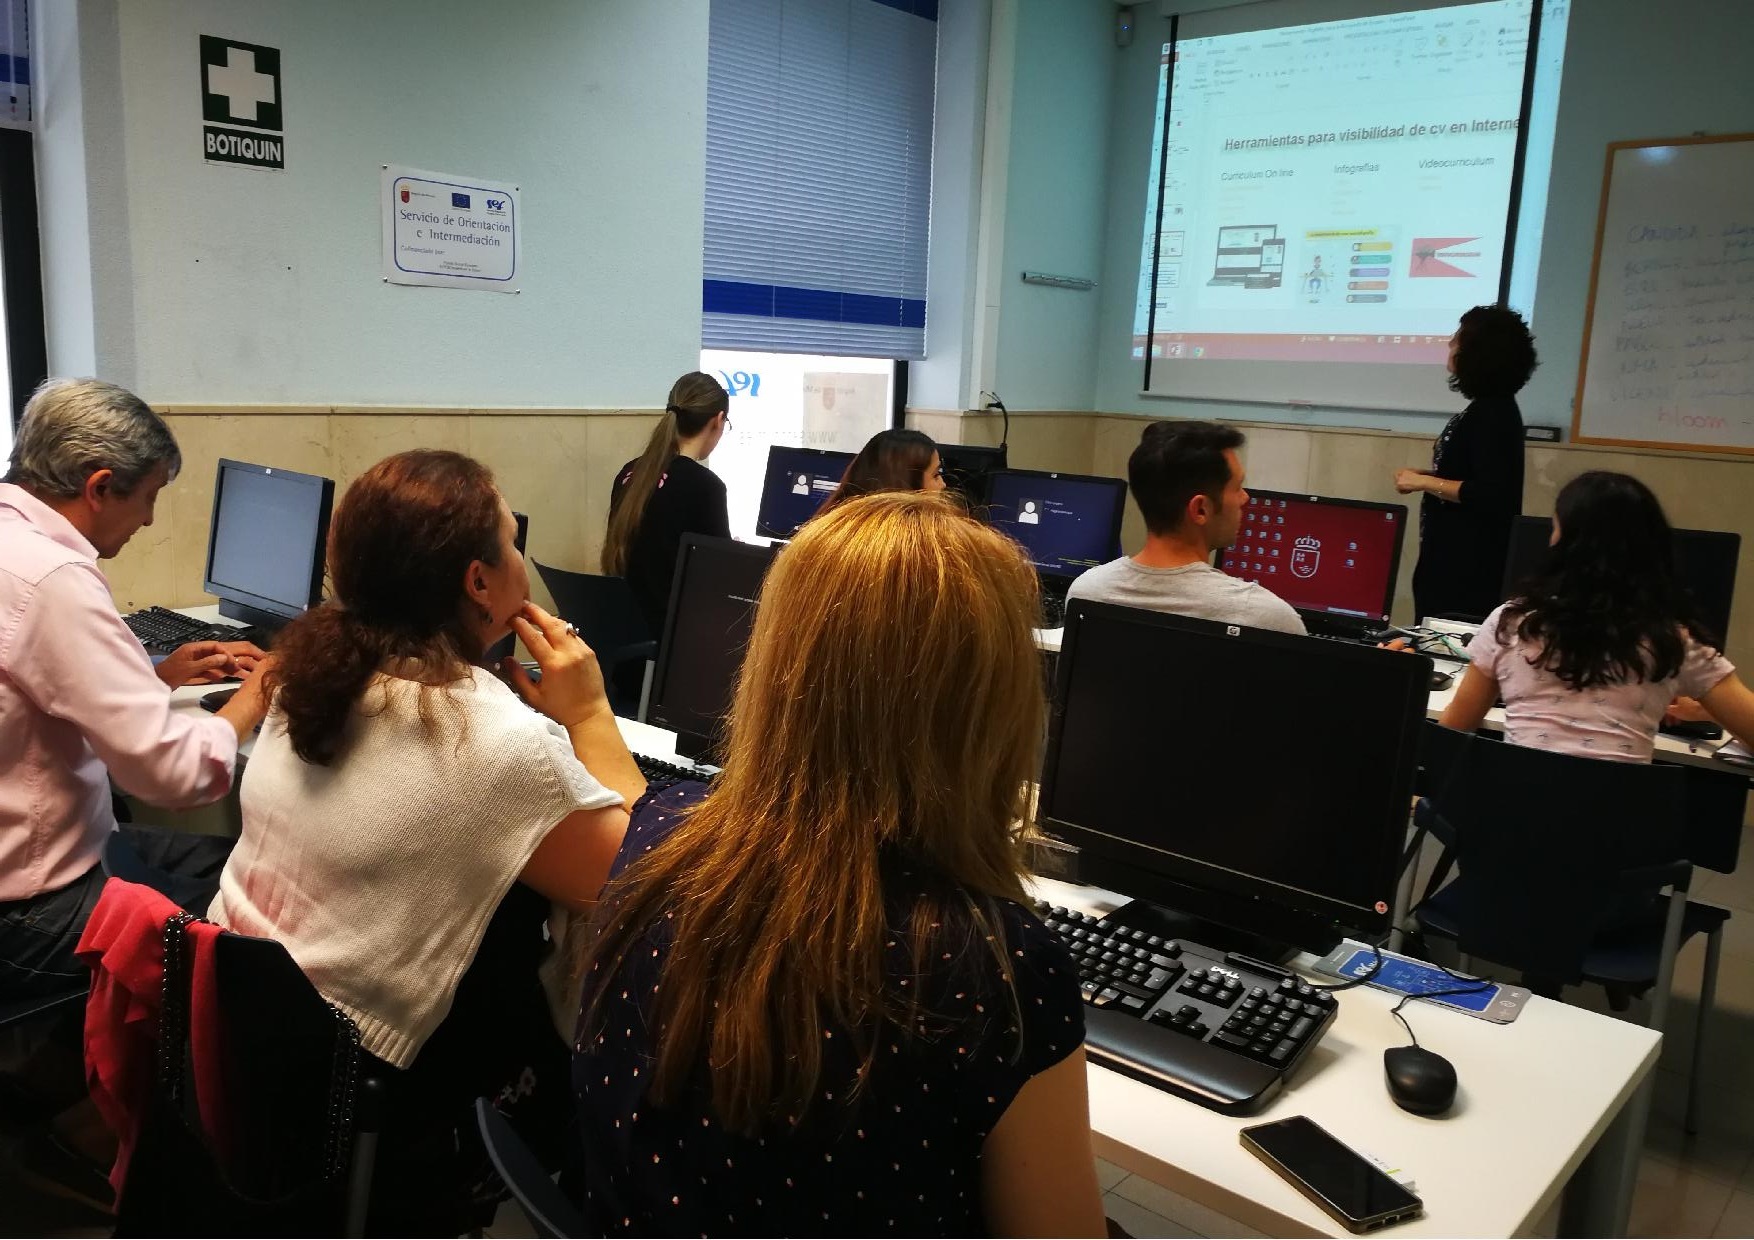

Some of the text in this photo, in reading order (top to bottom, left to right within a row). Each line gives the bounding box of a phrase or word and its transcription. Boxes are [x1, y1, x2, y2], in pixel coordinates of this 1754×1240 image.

[206, 132, 281, 162] BOTIQUIN
[1225, 117, 1521, 151] Herramientas para visibilidad de cv en Interne
[400, 208, 510, 233] Servicio de Orientación
[430, 228, 500, 246] Intermediación
